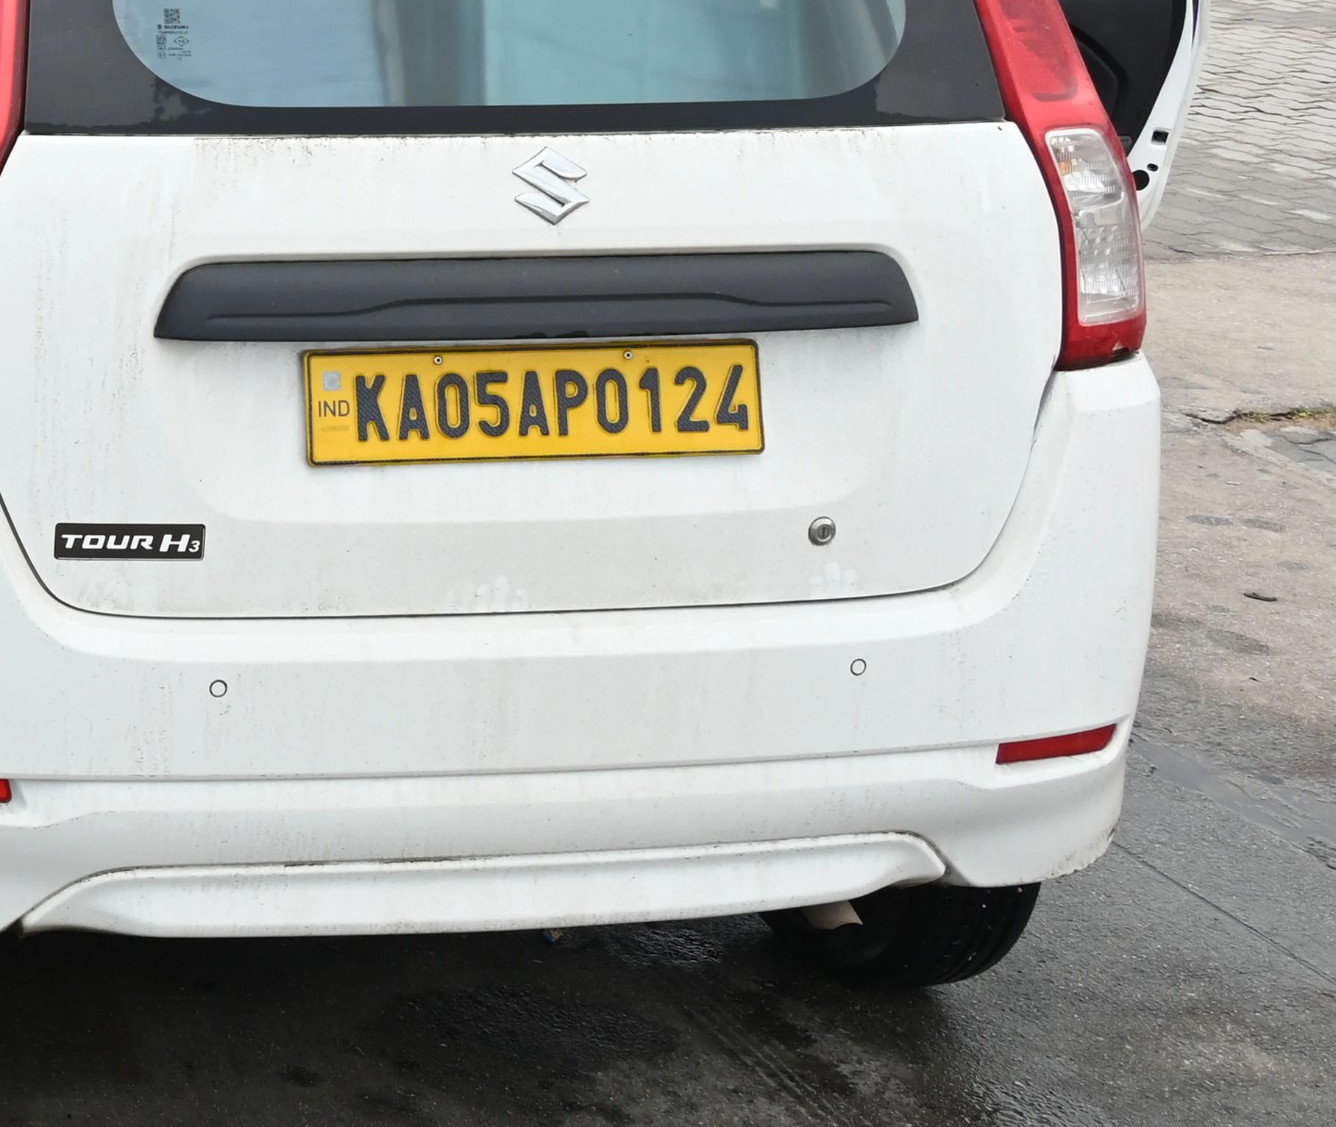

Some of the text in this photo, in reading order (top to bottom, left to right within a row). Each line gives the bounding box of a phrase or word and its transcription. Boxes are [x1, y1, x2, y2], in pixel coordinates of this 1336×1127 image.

[318, 400, 350, 417] IND
[355, 364, 749, 442] KA05AP0124
[61, 534, 154, 550] TOUR
